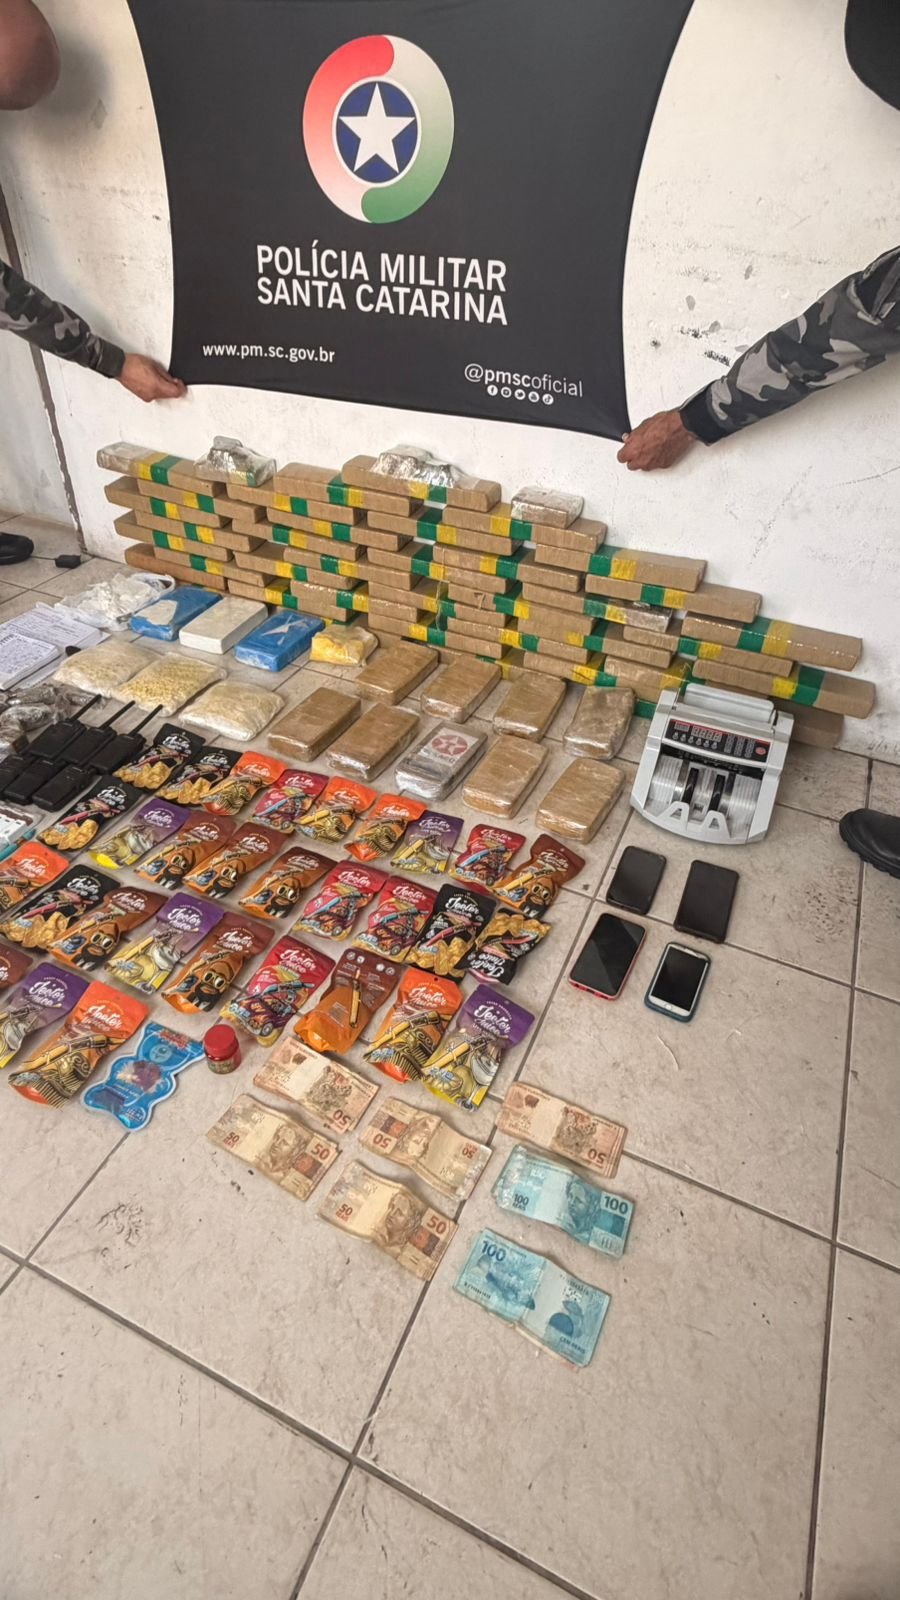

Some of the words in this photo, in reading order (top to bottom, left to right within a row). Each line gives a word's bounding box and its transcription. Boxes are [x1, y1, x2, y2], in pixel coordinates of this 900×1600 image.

[256, 240, 370, 280] POLÍCIA
[380, 252, 508, 292] MILITAR
[257, 276, 347, 311] SANTA
[356, 283, 509, 326] CATARINA
[202, 344, 336, 363] www.pm.sc.gov.br
[464, 363, 584, 398] @pmscoficial
[333, 1109, 352, 1127] 50
[226, 1131, 240, 1144] 50
[373, 1133, 392, 1150] 50
[311, 1143, 331, 1161] 50
[588, 1148, 607, 1165] 50
[514, 1193, 530, 1205] 100
[604, 1196, 629, 1215] 100
[339, 1204, 353, 1216] 50
[426, 1215, 447, 1235] 50
[481, 1240, 506, 1262] 100
